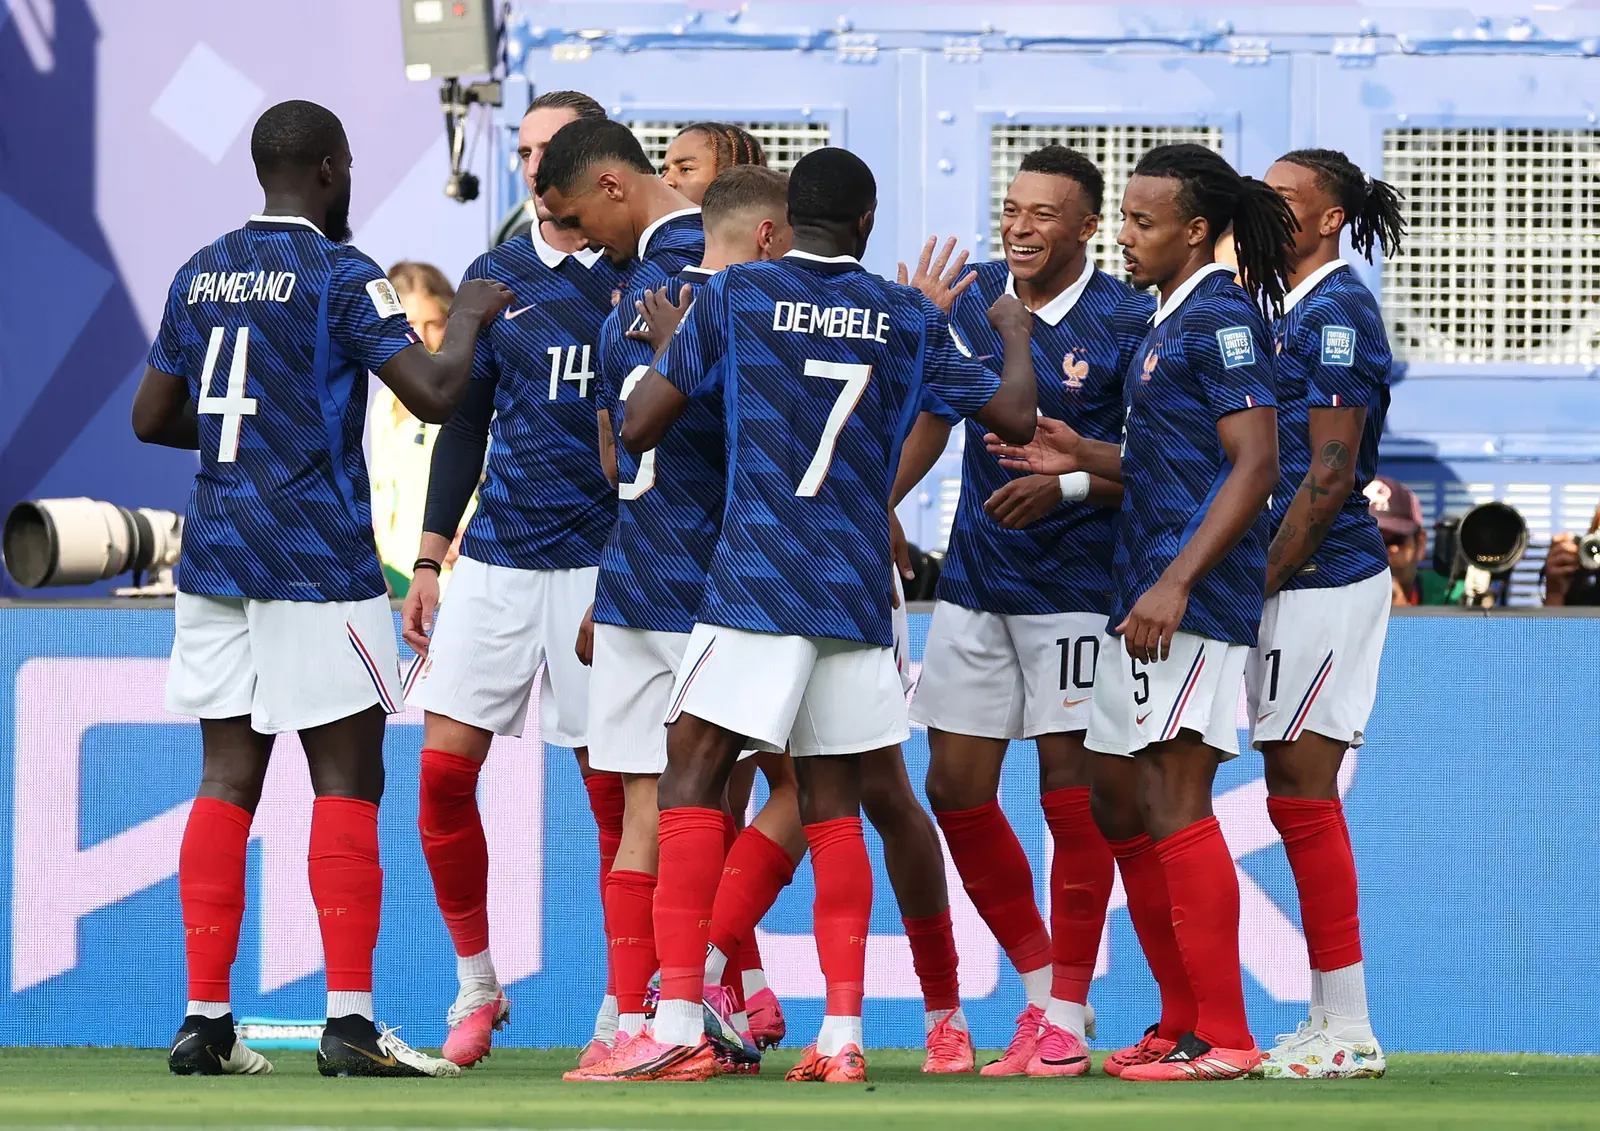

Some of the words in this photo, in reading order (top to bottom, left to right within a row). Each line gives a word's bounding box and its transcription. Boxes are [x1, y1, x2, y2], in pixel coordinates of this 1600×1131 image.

[188, 271, 296, 305] UPAMECANO
[772, 301, 890, 344] DEMBELE
[1224, 332, 1247, 341] FOOTBALL
[1327, 331, 1350, 339] FOOTBALL
[1225, 338, 1249, 349] UNITES
[1326, 338, 1350, 348] UNITES
[547, 344, 595, 400] 14
[197, 326, 258, 463] 4
[795, 358, 873, 498] 7
[1056, 635, 1100, 690] 10
[1131, 658, 1150, 705] 5
[186, 926, 220, 937] FFF
[611, 937, 640, 948] FFF
